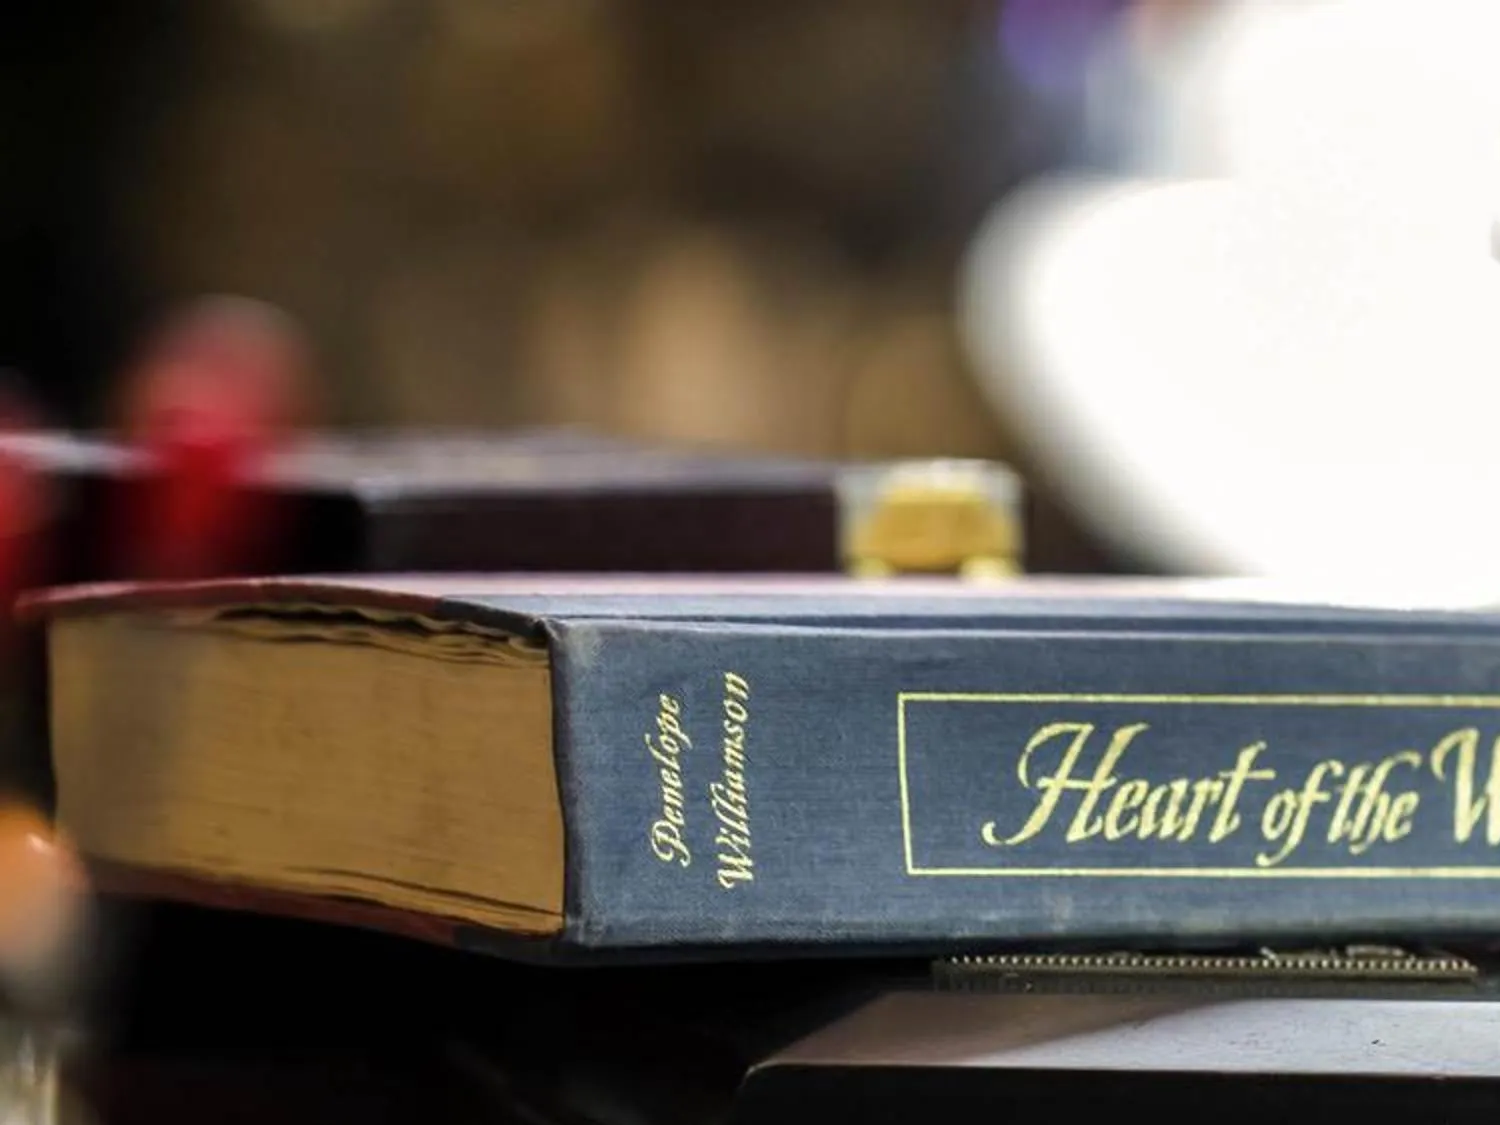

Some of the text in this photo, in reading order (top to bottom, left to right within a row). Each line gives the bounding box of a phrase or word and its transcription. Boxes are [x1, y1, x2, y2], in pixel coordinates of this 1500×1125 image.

[645, 694, 692, 868] Penelope
[710, 671, 754, 889] Williamson
[982, 722, 1276, 845] Heart
[1256, 760, 1344, 867] of
[1327, 751, 1422, 855] the
